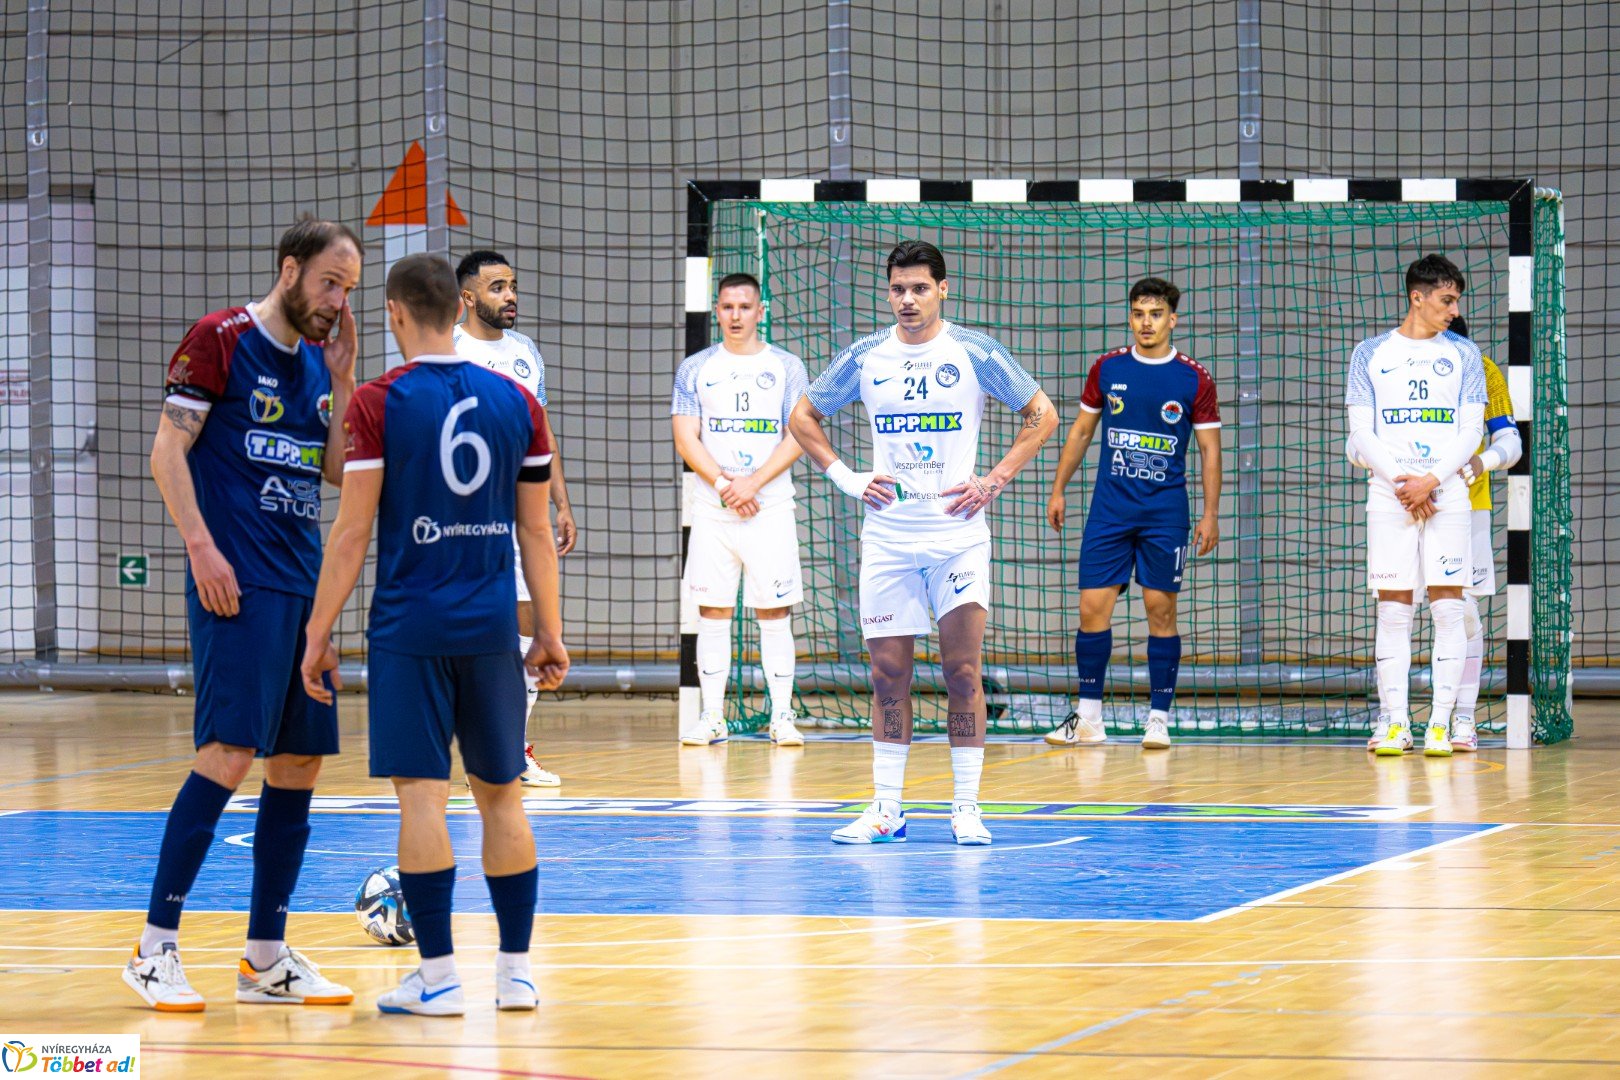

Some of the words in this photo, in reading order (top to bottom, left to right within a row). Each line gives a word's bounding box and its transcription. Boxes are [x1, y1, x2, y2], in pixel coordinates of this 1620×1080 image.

[258, 375, 278, 388] JAKO
[904, 375, 929, 401] 24
[1111, 383, 1128, 391] JAKO
[1408, 379, 1429, 401] 26
[735, 391, 750, 412] 13
[439, 396, 492, 497] 6
[1110, 466, 1166, 482] STUDIO
[260, 496, 320, 519] STUD
[442, 521, 510, 537] NYÍREGYHÁZA
